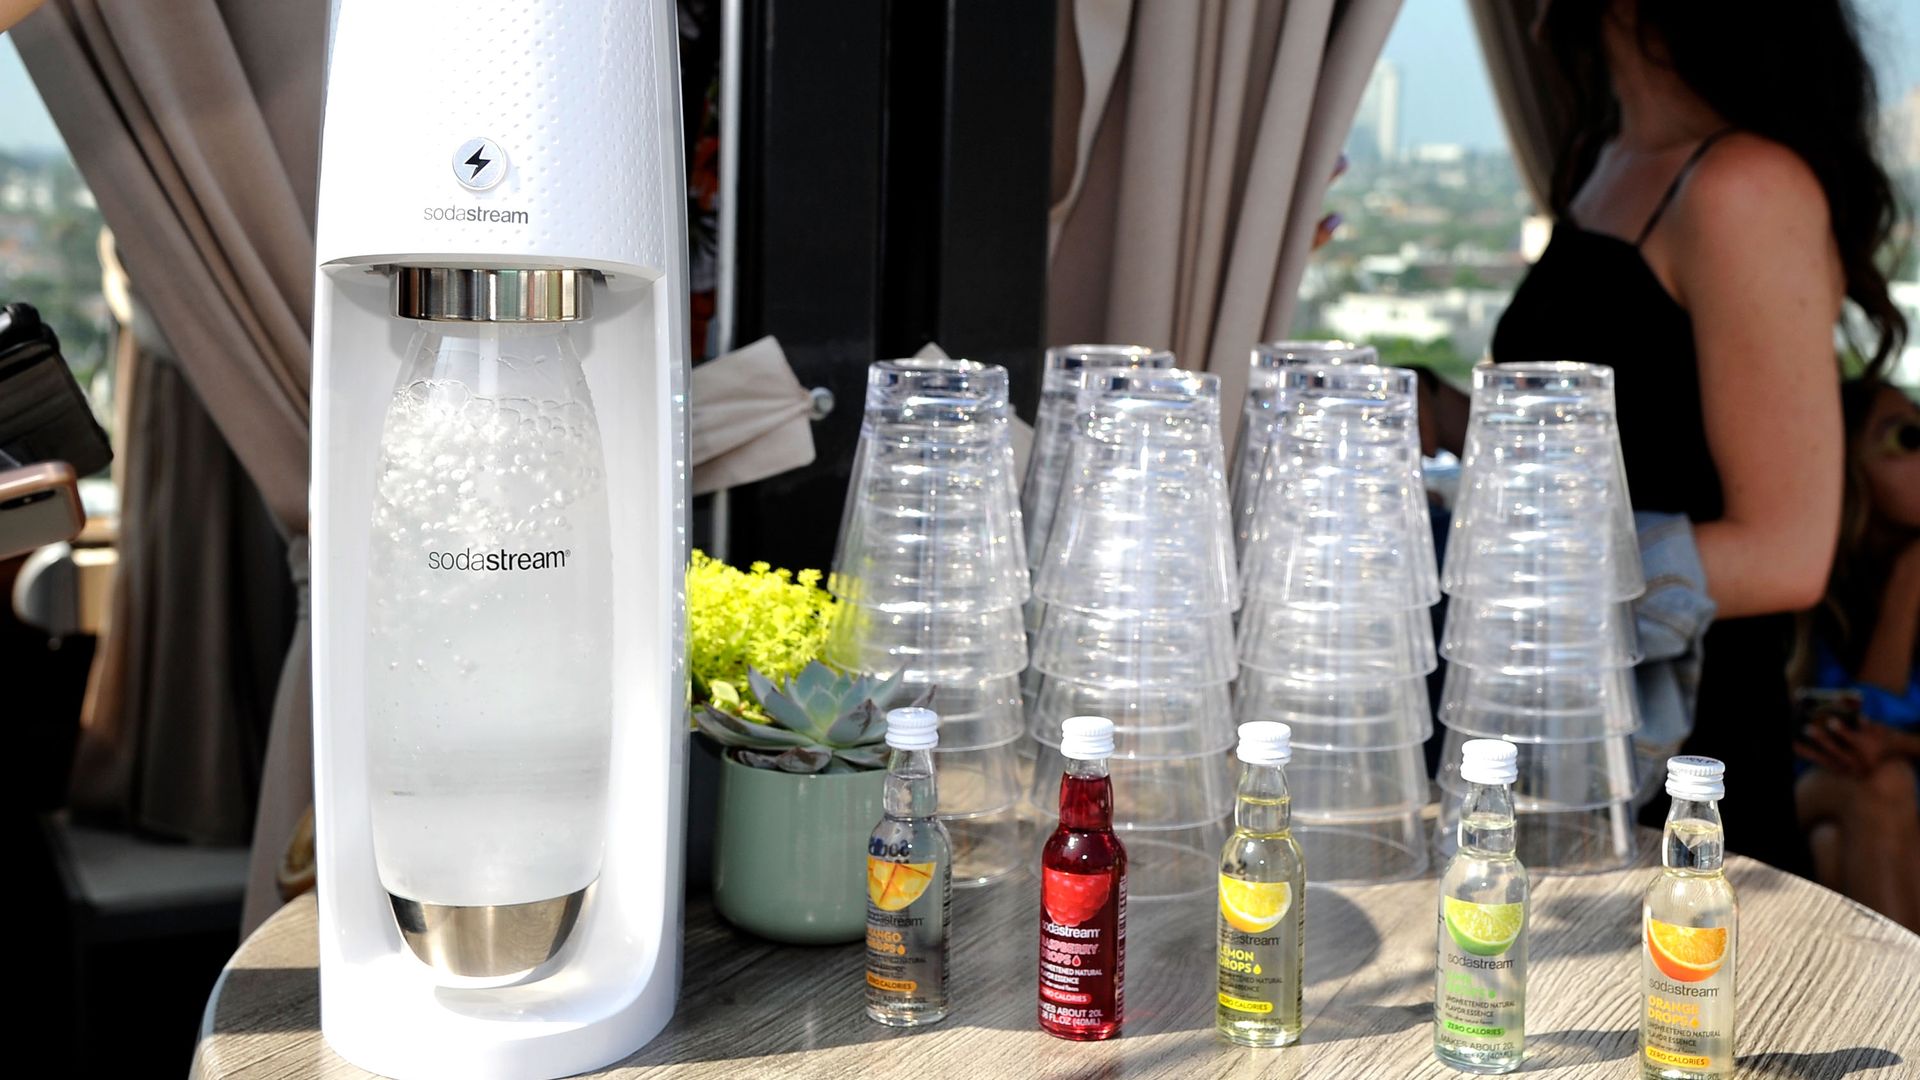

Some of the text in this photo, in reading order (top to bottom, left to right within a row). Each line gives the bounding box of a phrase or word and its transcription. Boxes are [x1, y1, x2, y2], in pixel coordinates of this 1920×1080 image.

[423, 204, 529, 224] sodastream
[867, 911, 923, 927] stream
[1221, 929, 1279, 946] stream
[1220, 944, 1254, 961] LEMON
[1219, 957, 1252, 974] DROPS
[1447, 953, 1514, 970] sodastream
[1649, 979, 1718, 997] sodastream
[1040, 1000, 1057, 1013] KES
[1057, 1006, 1087, 1018] ABOUT
[1234, 1001, 1268, 1011] CALORIES
[1648, 994, 1700, 1014] ORANGE
[1466, 1009, 1494, 1017] ESSENCE
[1648, 1007, 1688, 1028] DROPS
[1447, 1022, 1502, 1036] ZERO CALORIES
[1470, 1042, 1500, 1052] ABOUT
[1649, 1049, 1705, 1066] ZERO CALORIES
